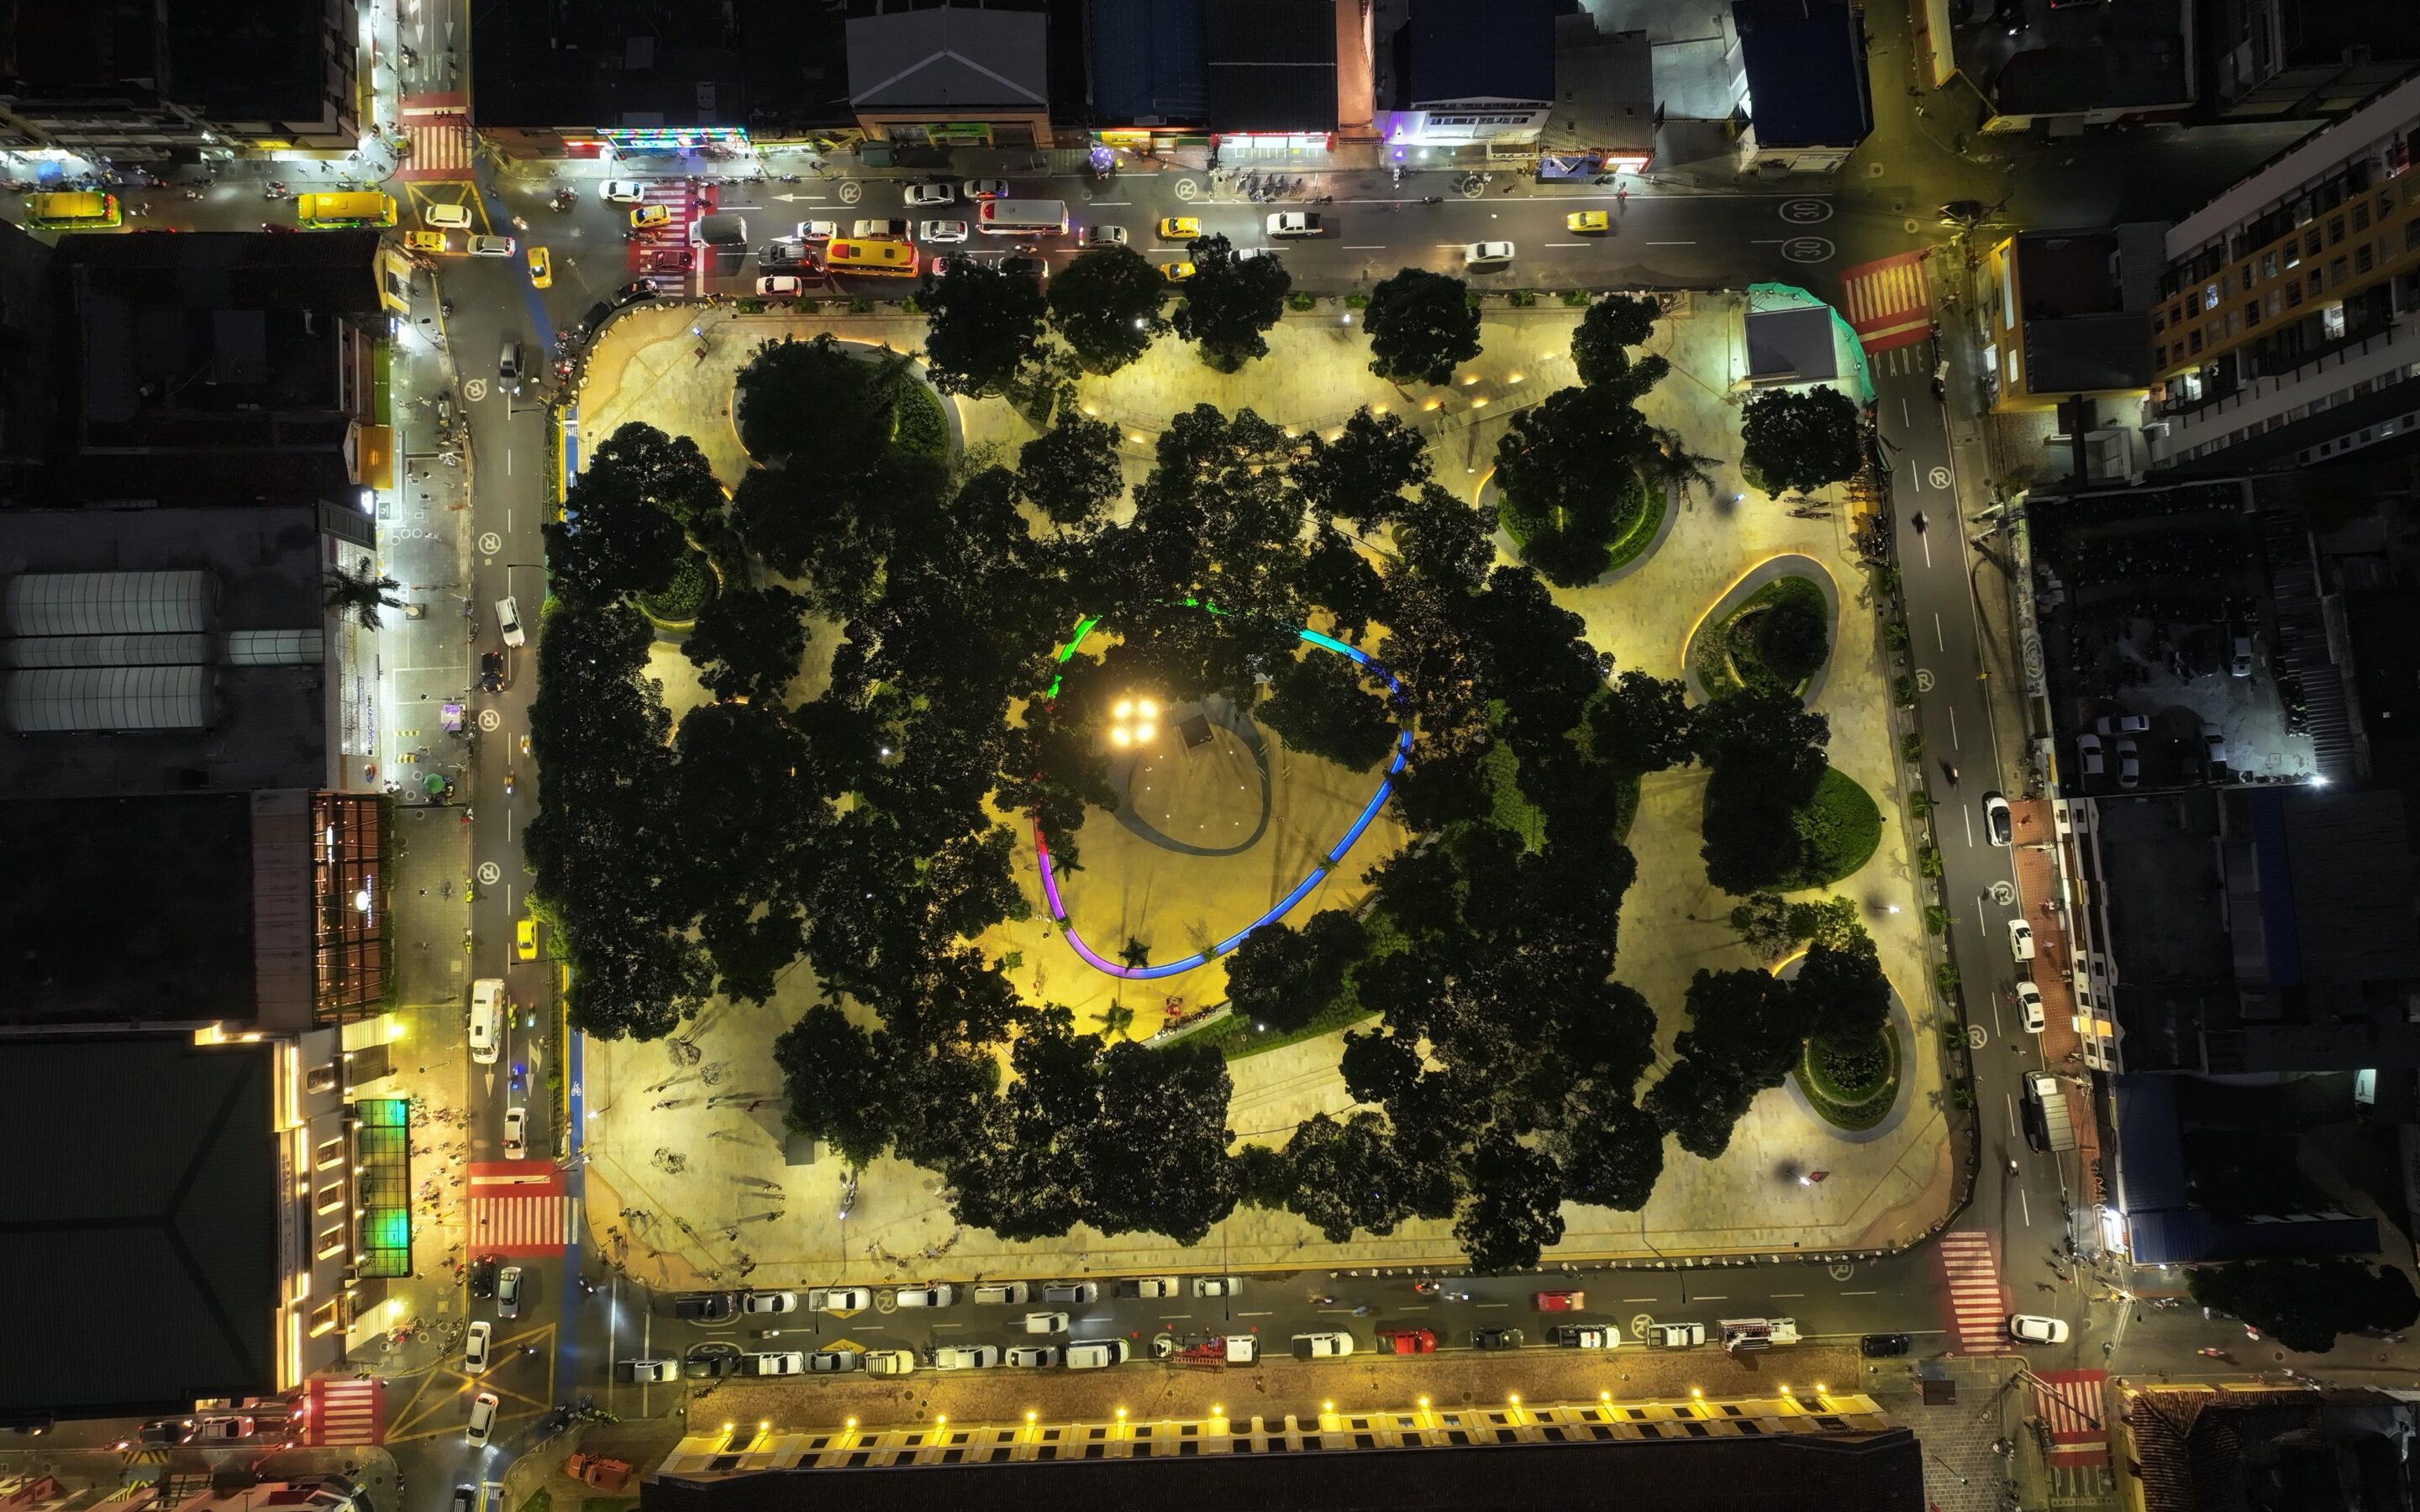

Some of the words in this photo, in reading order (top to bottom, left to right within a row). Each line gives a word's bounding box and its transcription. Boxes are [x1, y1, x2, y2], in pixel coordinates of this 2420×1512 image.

[1793, 202, 1820, 218] 30
[1794, 241, 1821, 257] 30
[1873, 344, 1924, 379] PARE
[2054, 1464, 2104, 1497] PARE
